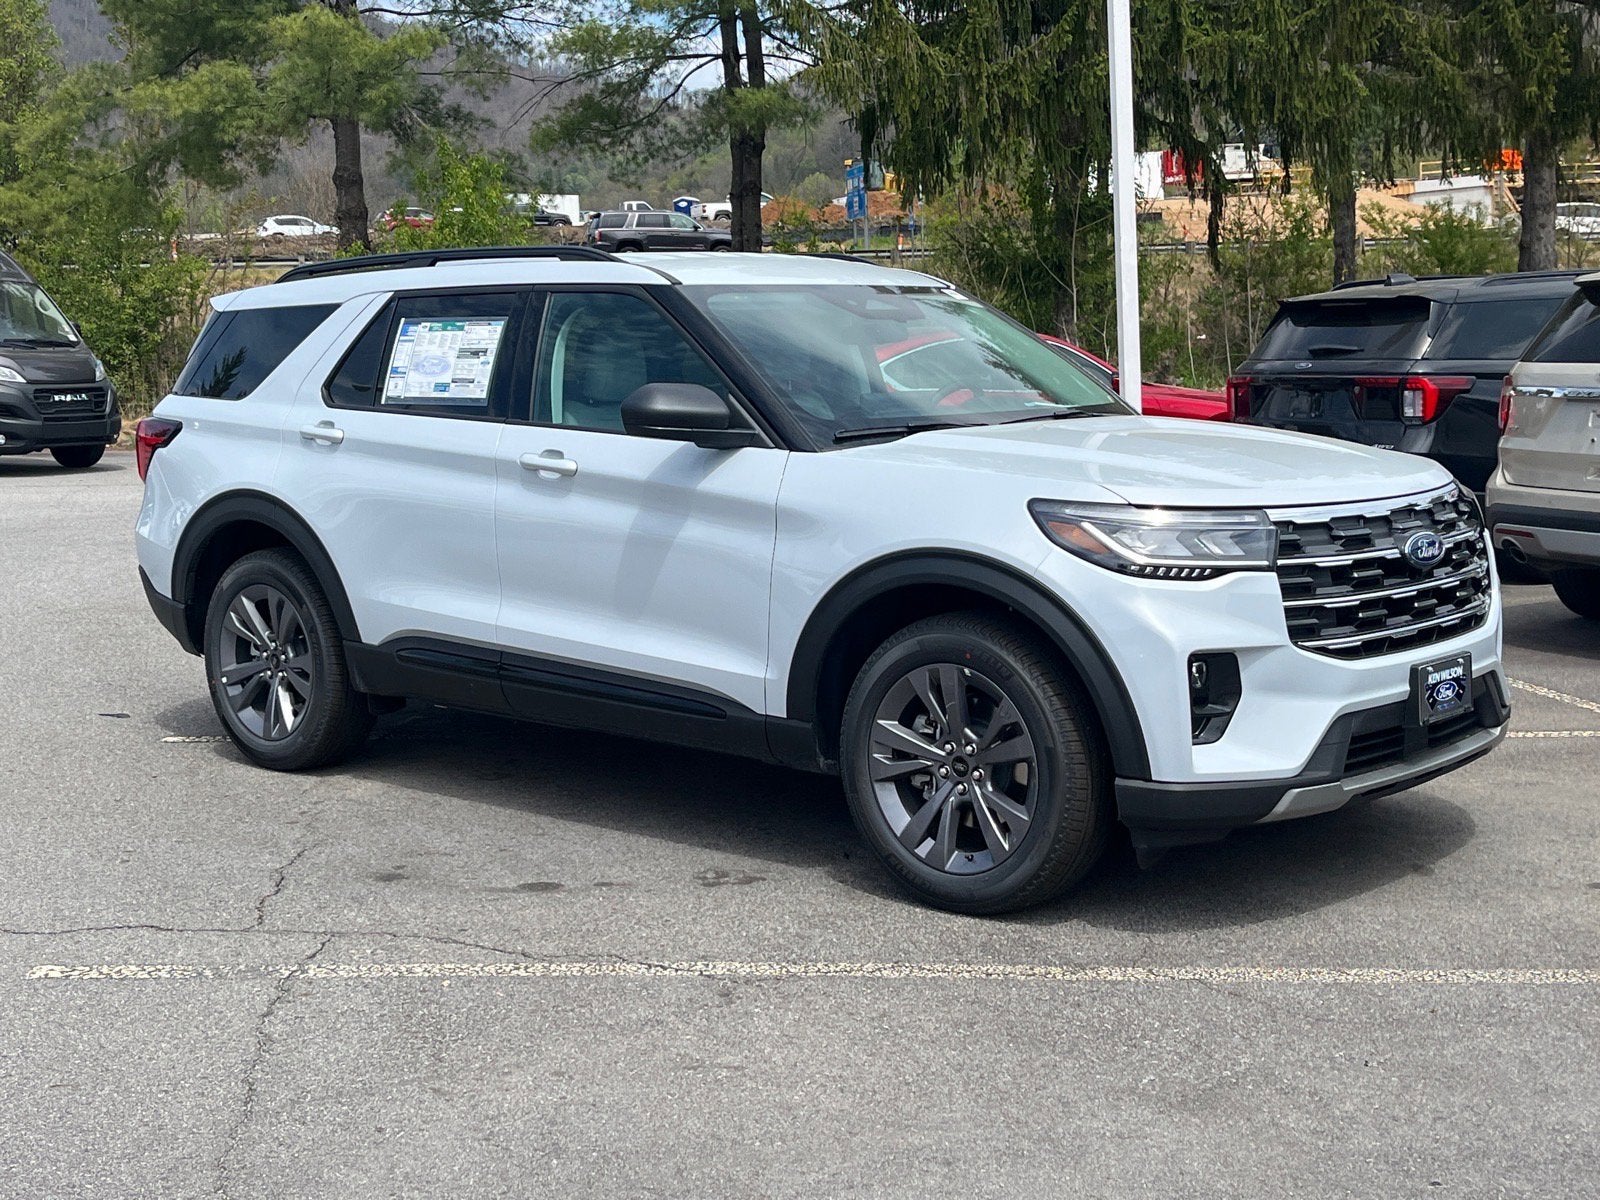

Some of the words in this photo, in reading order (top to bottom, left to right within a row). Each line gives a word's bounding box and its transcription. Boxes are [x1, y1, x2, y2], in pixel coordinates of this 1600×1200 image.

[1417, 538, 1440, 558] Ford
[1427, 672, 1440, 684] KEN
[1440, 665, 1463, 680] WILSON
[1438, 684, 1454, 699] Ford
